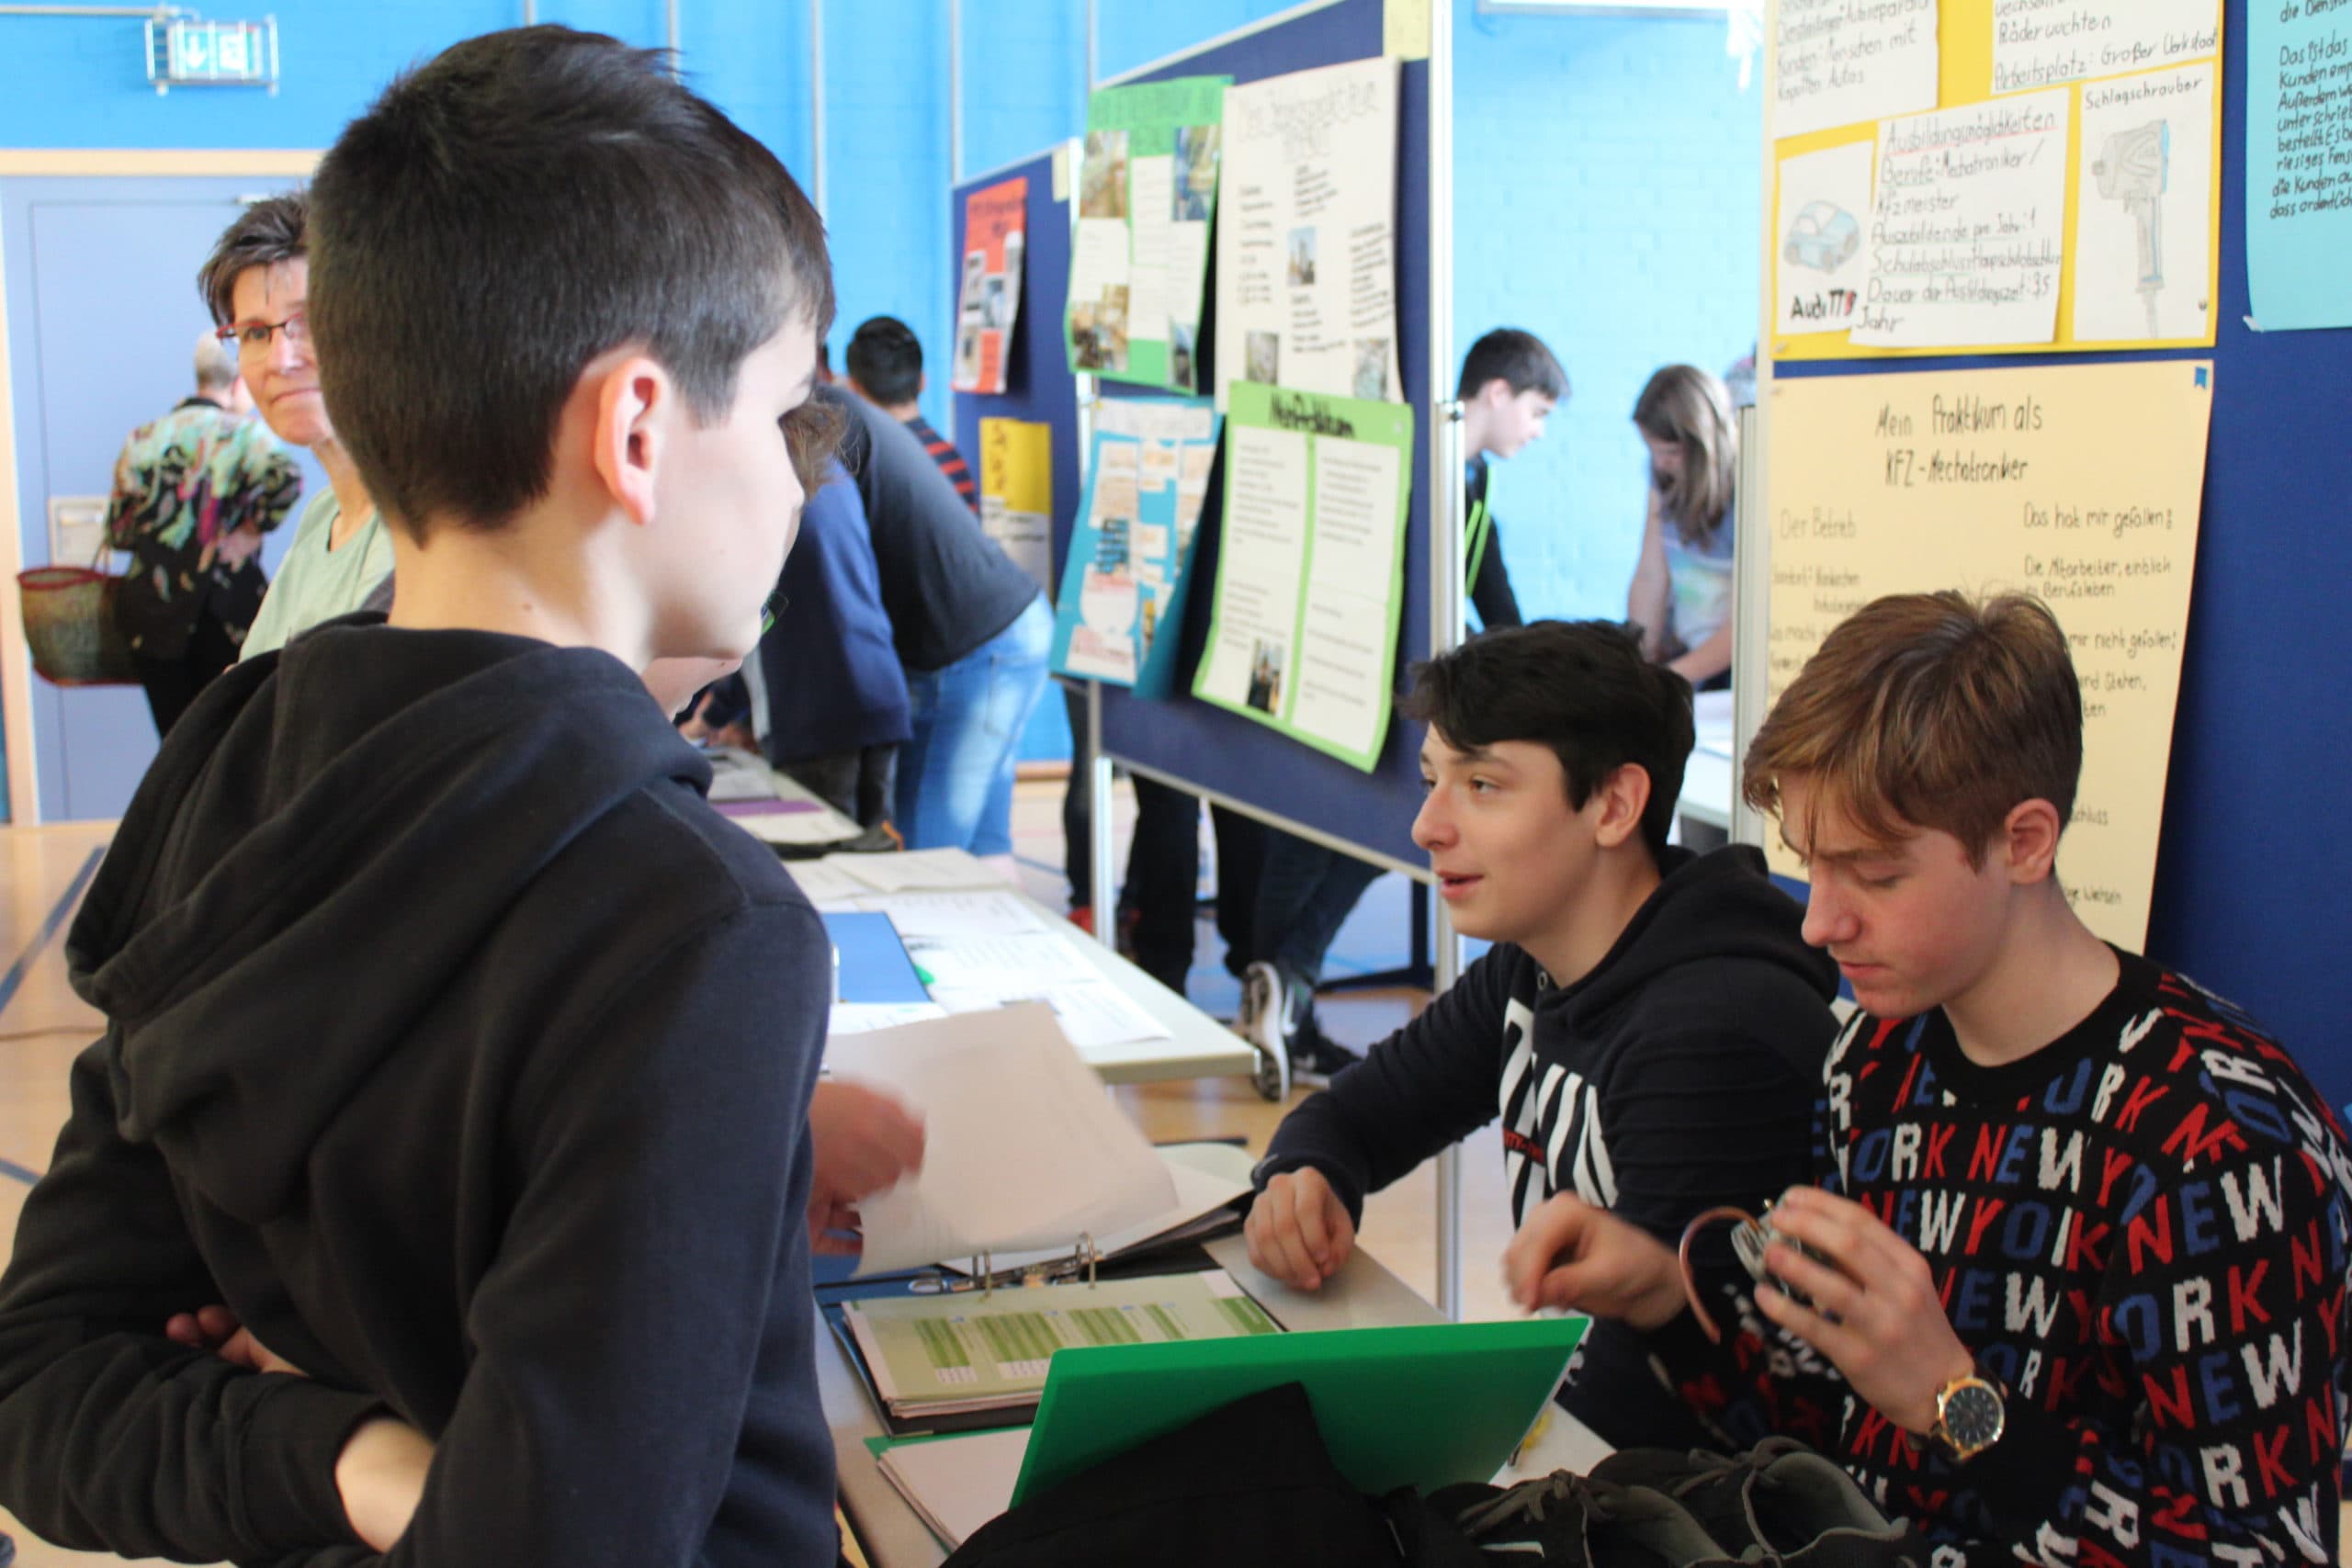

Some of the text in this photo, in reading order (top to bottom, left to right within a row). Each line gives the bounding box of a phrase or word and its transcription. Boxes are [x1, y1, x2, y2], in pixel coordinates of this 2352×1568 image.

[1889, 17, 1917, 51] mit
[2279, 45, 2304, 66] Das
[2324, 28, 2348, 59] das
[2279, 61, 2328, 89] Kunden
[2085, 74, 2203, 110] Schlagschrauber
[2272, 177, 2290, 198] die
[2294, 167, 2335, 195] Kunden
[2270, 197, 2296, 220] dass
[1791, 292, 1826, 319] Audi
[1855, 304, 1905, 334] Jahr
[1875, 402, 1913, 437] Mein
[2013, 393, 2043, 431] als
[1780, 508, 1808, 541] Der
[2023, 501, 2049, 529] Das
[2054, 503, 2081, 530] hat
[2086, 509, 2109, 527] mir
[2024, 554, 2044, 578] Die
[2095, 628, 2125, 649] nicht
[2127, 1153, 2285, 1277] NEW
[2142, 1316, 2302, 1427] NEW
